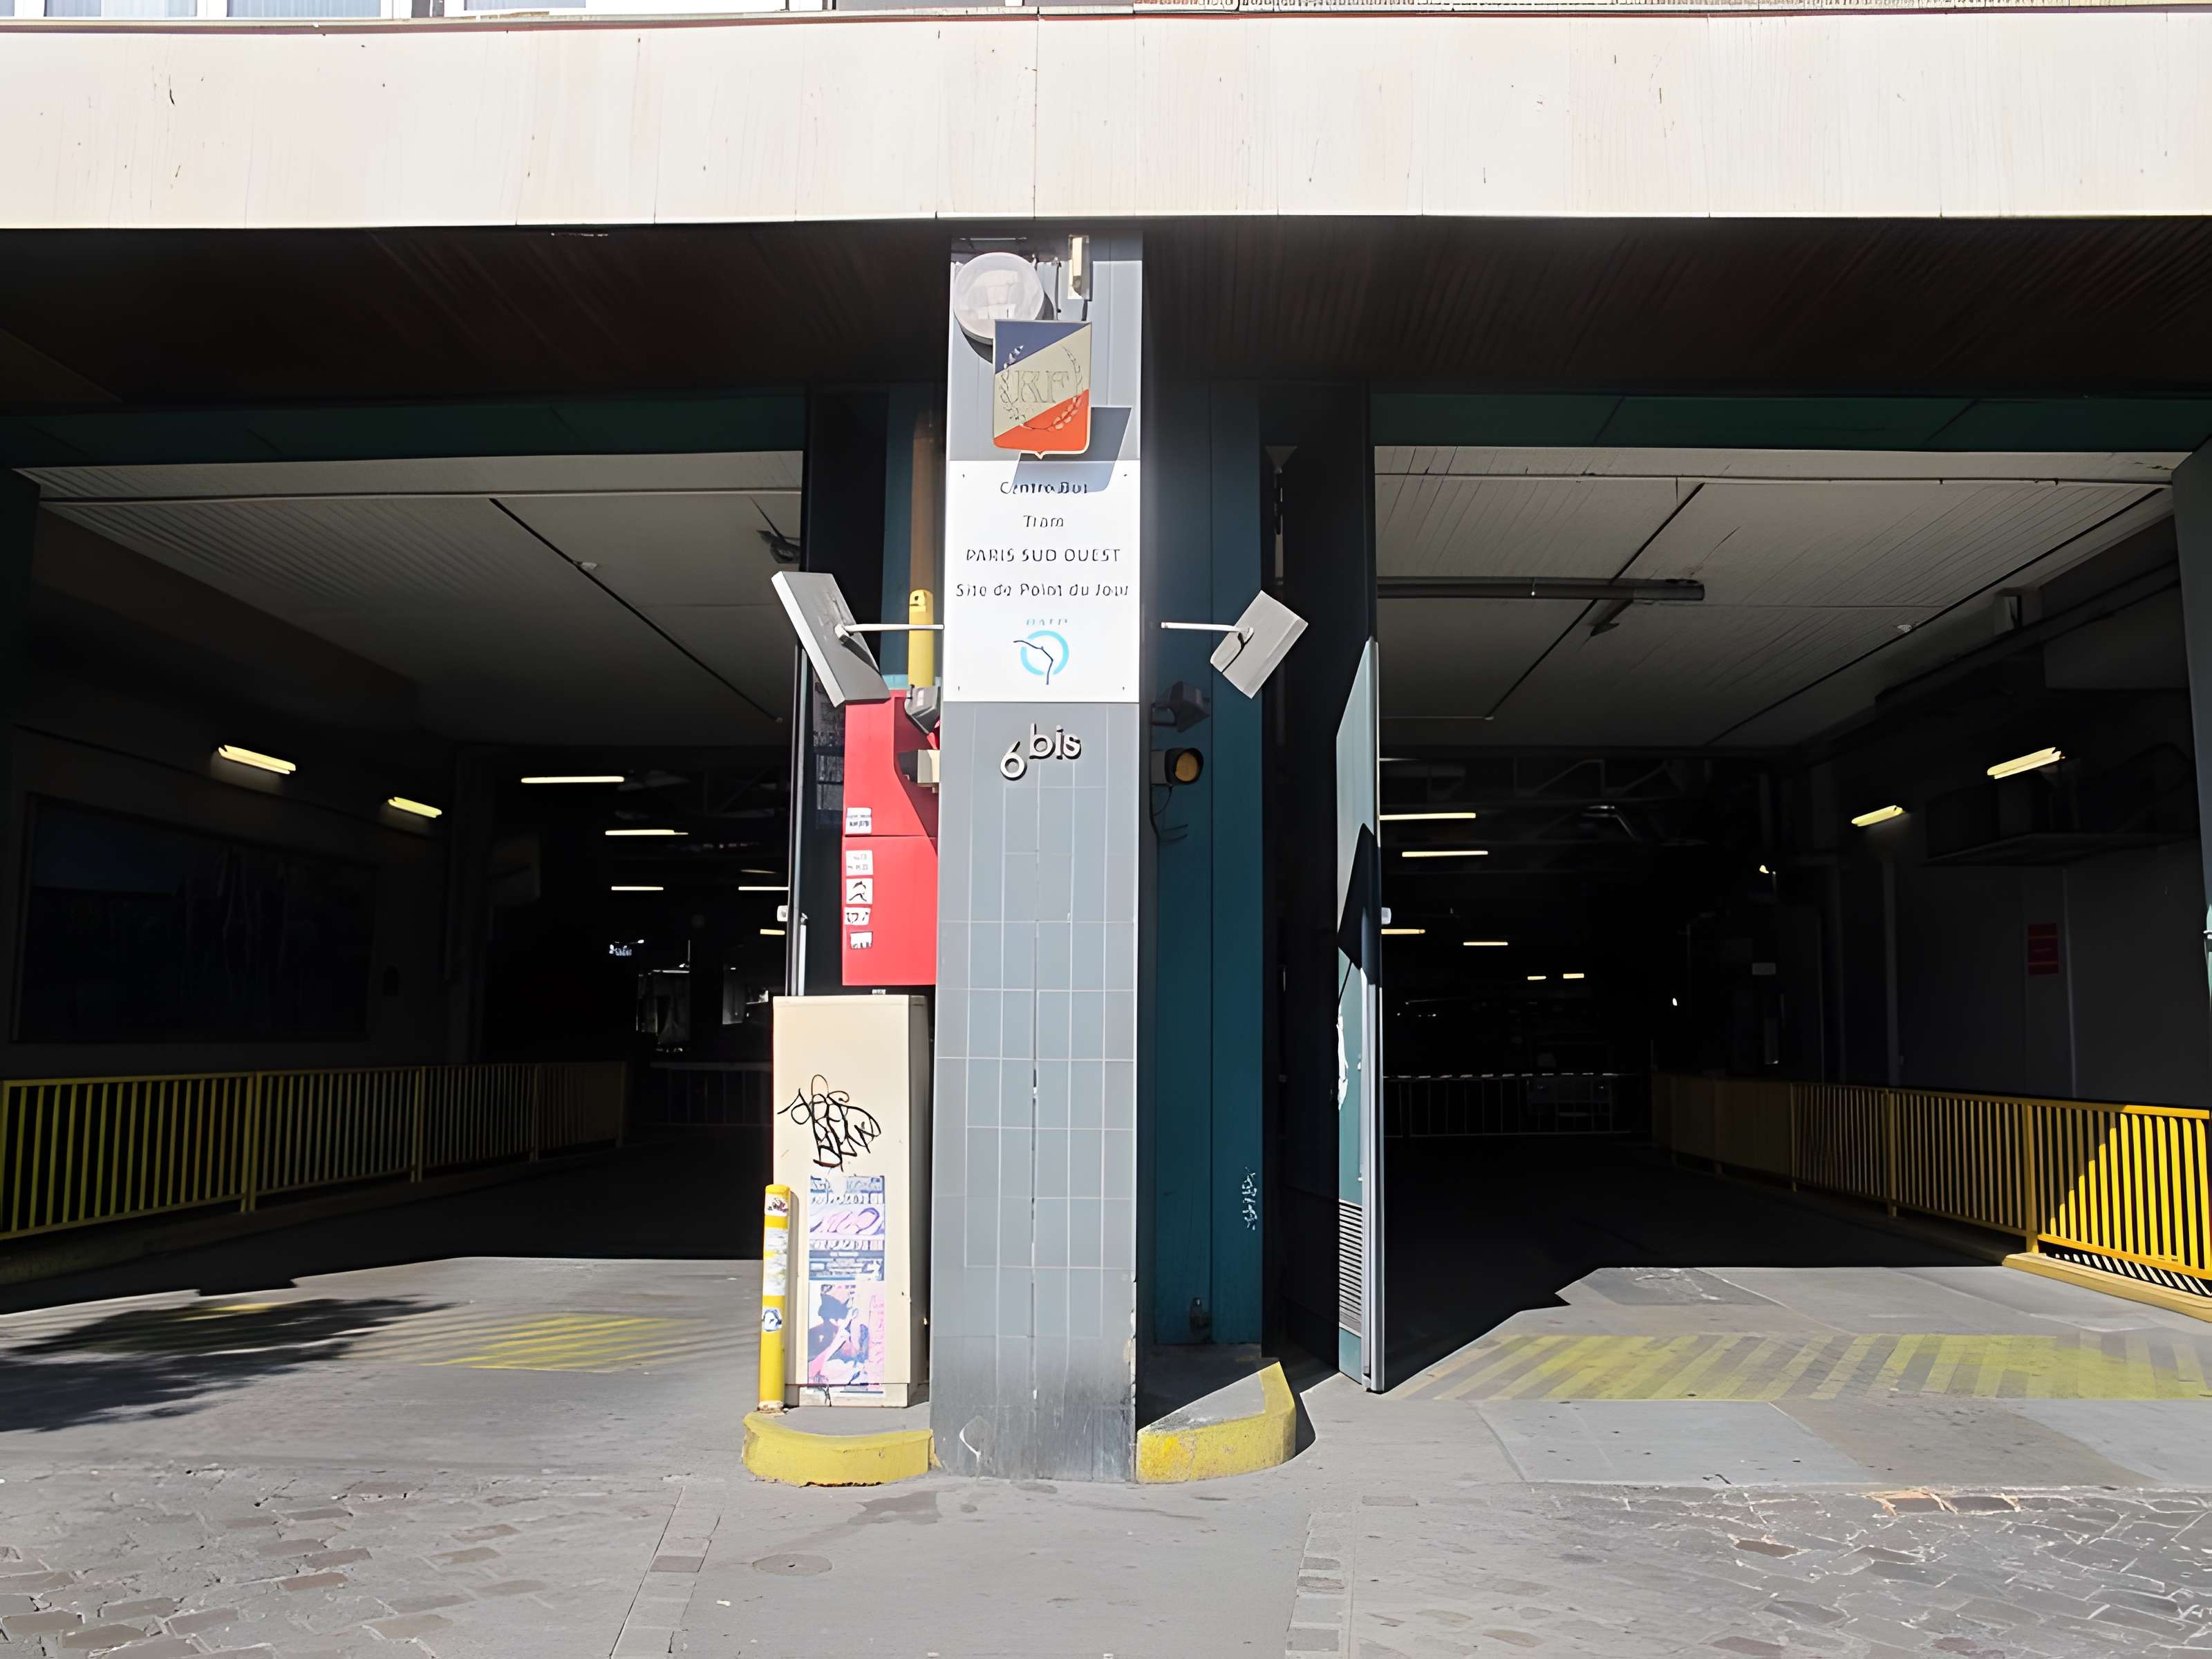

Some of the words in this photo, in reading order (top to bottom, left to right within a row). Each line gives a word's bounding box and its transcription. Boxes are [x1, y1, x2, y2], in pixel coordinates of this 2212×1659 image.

[966, 548, 1014, 562] PARIS
[1021, 548, 1057, 562] SUD
[1065, 548, 1121, 562] OUEST
[1020, 583, 1062, 597] Point
[1069, 583, 1089, 597] du
[1000, 741, 1027, 780] 6
[1029, 723, 1081, 760] bis
